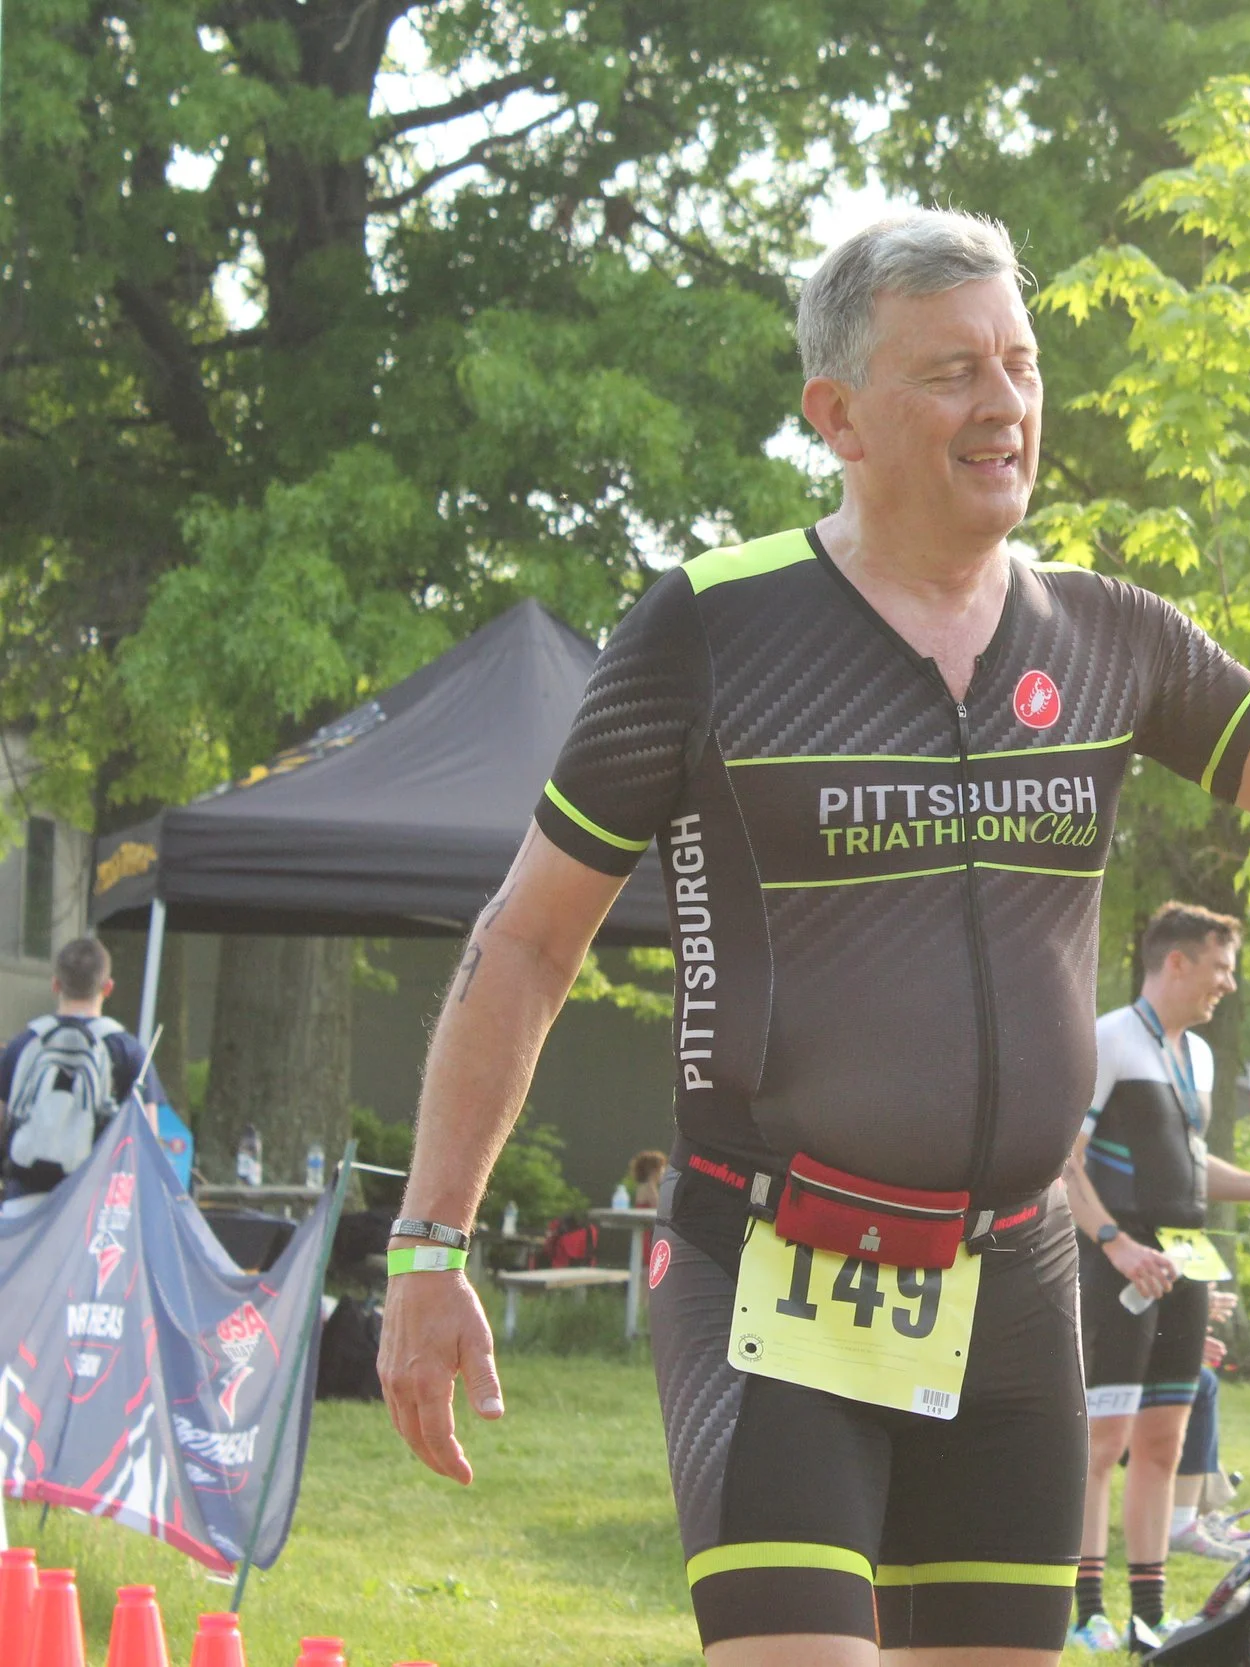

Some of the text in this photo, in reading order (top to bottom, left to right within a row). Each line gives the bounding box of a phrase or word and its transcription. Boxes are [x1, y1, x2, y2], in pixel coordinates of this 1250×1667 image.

[819, 776, 1097, 825] PITTSBURGH
[819, 812, 1098, 856] TRIATHLON Club
[670, 813, 717, 1091] PITTSBURGH
[689, 1153, 746, 1190] IRONMAN
[776, 1239, 943, 1339] 149
[216, 1301, 265, 1341] USA
